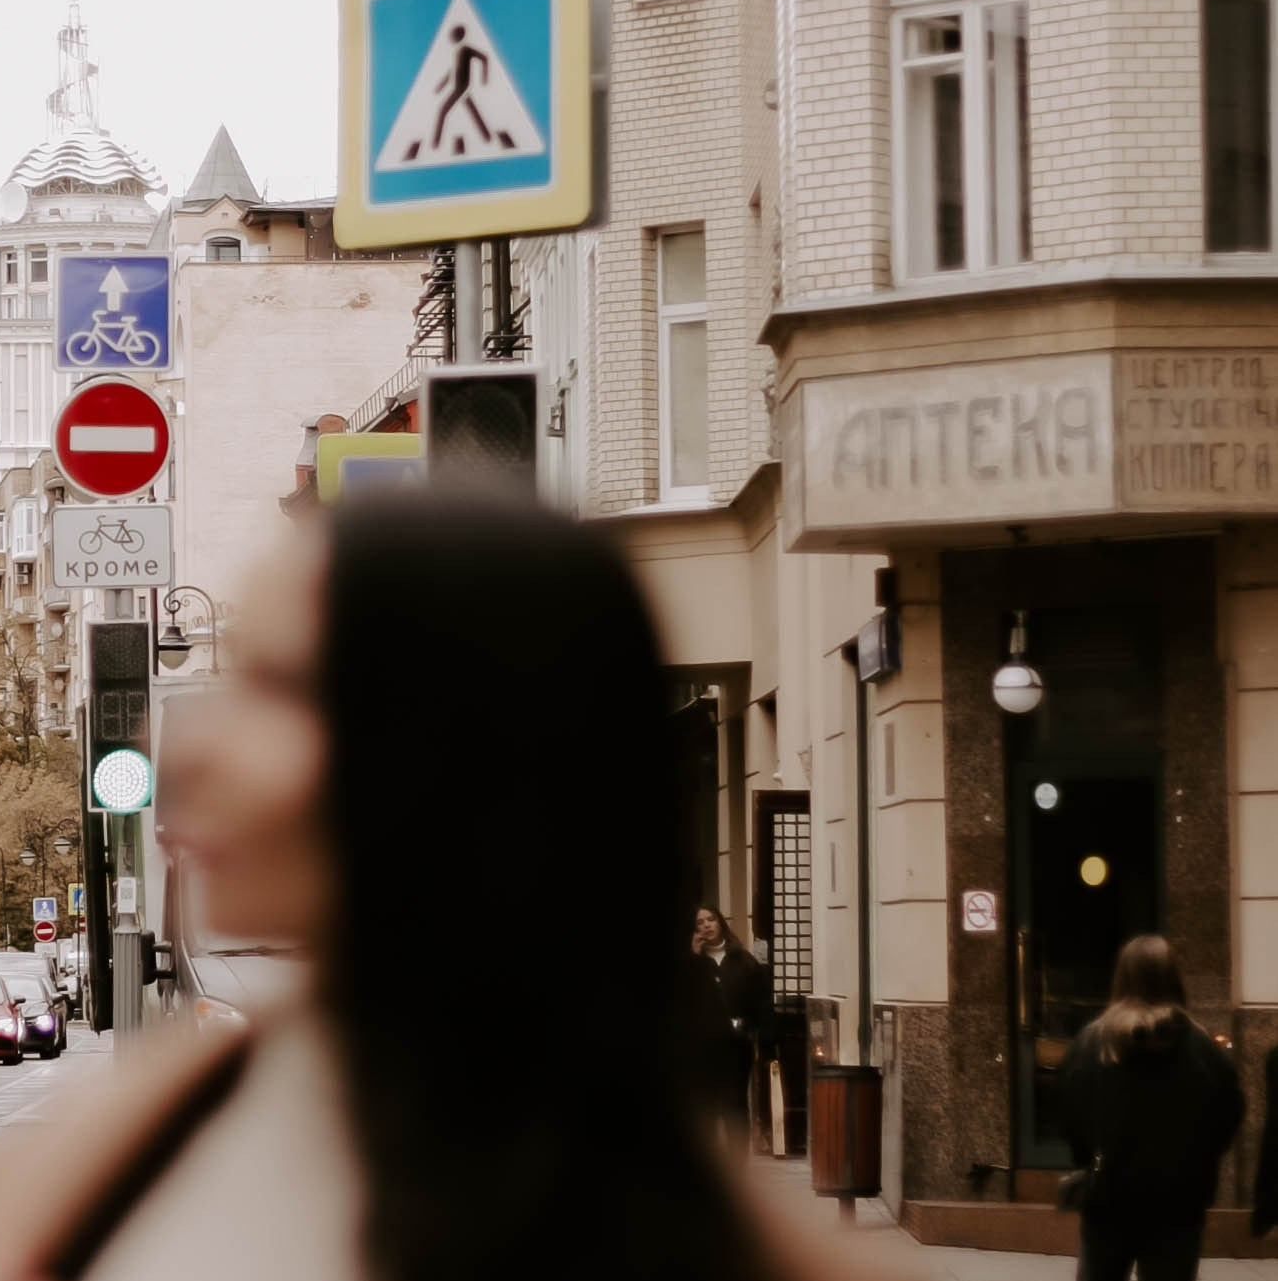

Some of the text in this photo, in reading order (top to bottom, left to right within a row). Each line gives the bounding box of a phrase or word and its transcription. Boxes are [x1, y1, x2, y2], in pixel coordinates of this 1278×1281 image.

[1125, 398, 1278, 429] СТУДЕНЧ
[831, 386, 1100, 489] АПТЕКА
[65, 559, 159, 584] кроме
